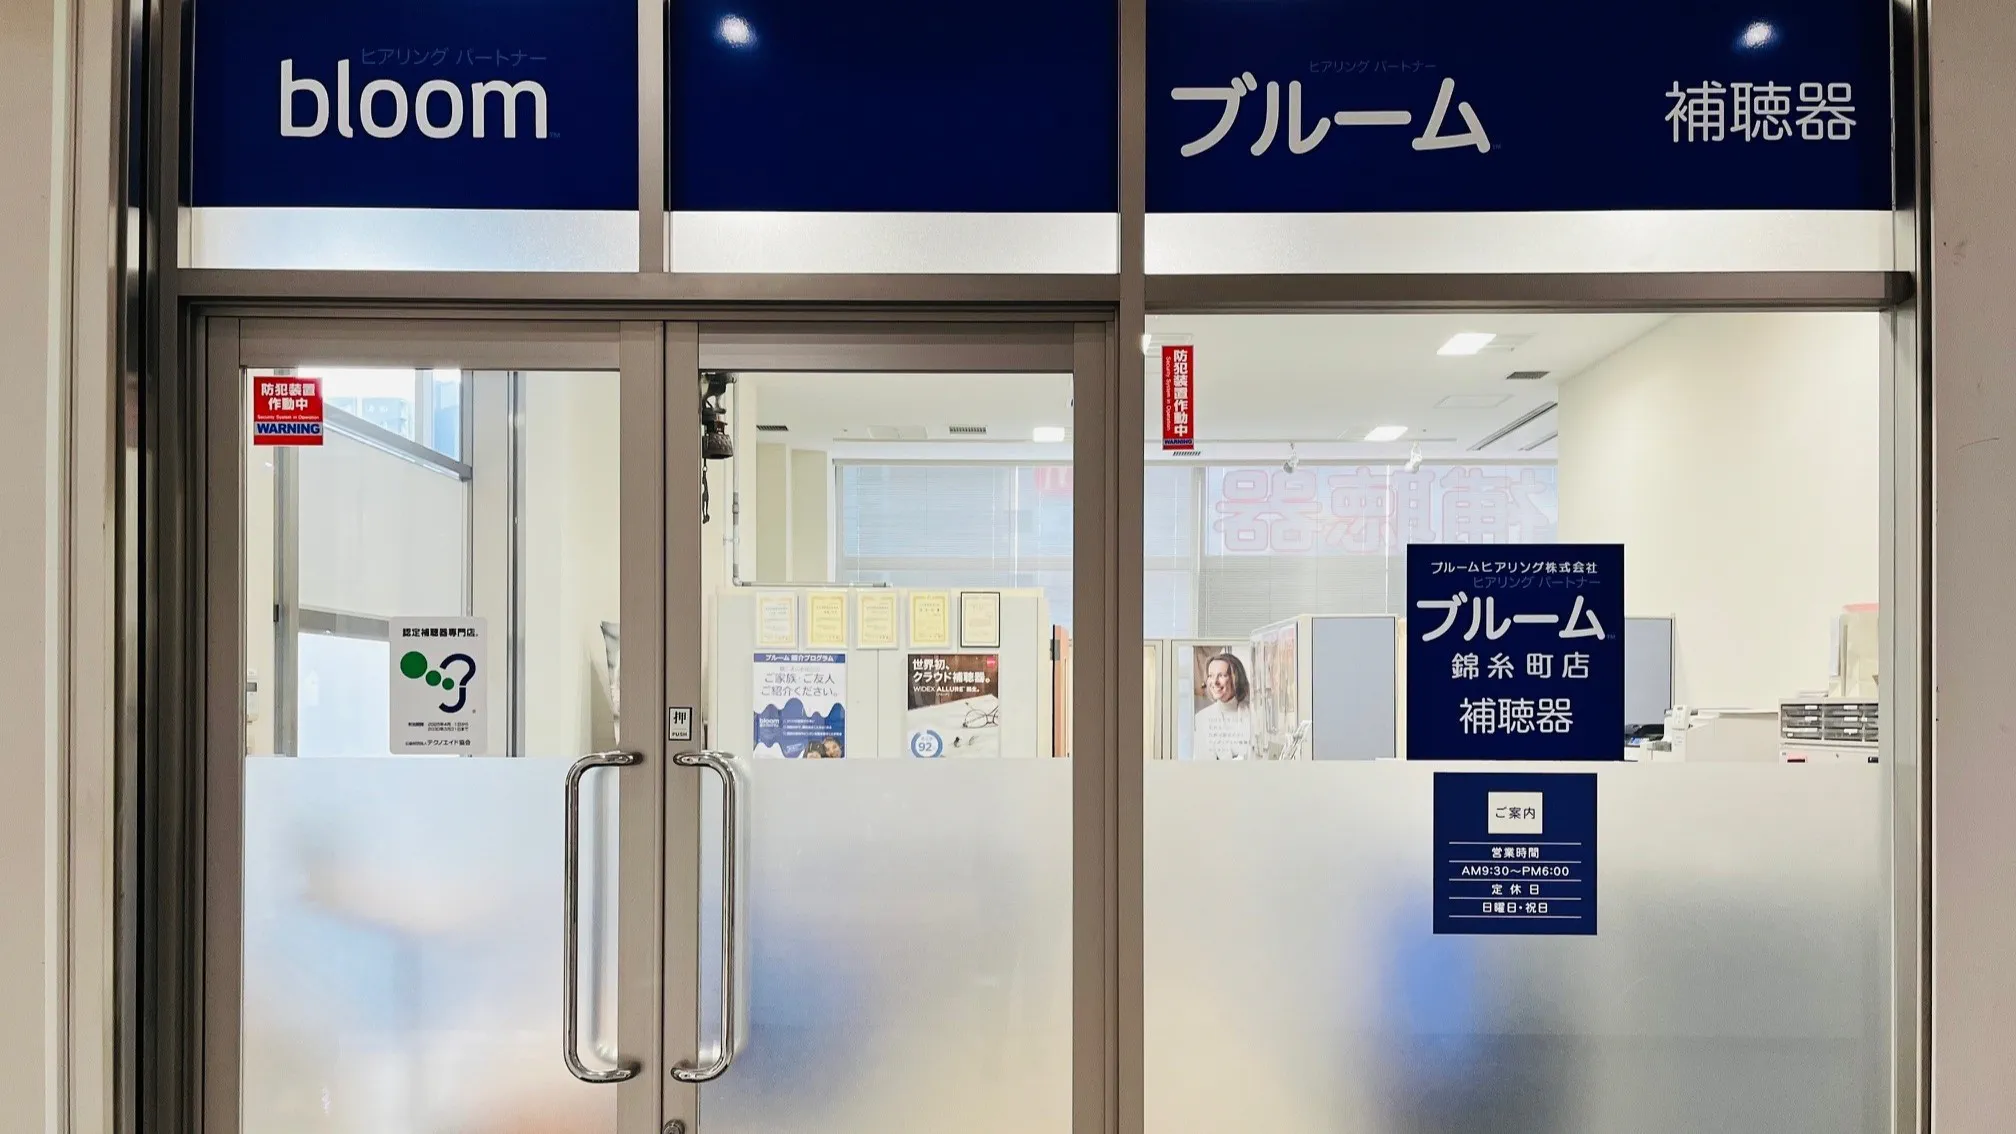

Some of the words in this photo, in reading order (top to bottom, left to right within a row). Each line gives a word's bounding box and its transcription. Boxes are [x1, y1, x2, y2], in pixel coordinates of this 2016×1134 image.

[361, 47, 450, 66] ヒアリング
[456, 48, 547, 67] パートナー
[1309, 60, 1370, 73] ヒアリング
[1374, 60, 1436, 73] パートナー
[280, 58, 548, 139] bloom
[1171, 71, 1491, 158] ブルーム
[1664, 79, 1857, 143] 補聴器
[261, 383, 315, 396] 防犯装置
[1173, 349, 1188, 437] 防犯装置作動中
[268, 397, 308, 411] 作動中
[257, 423, 320, 434] WARNING
[1431, 561, 1598, 575] ブルームヒアリング株式会社
[1473, 576, 1535, 589] ヒアリング
[1538, 576, 1600, 589] パートナー
[1416, 591, 1605, 641] ブルーム
[402, 628, 475, 637] 認定補聴器専門店
[1451, 652, 1590, 680] 錦糸町店
[1459, 697, 1574, 734] 補聴器
[1495, 806, 1536, 819] ご案内
[1491, 847, 1539, 859] 営業時間
[1491, 884, 1539, 895] 定休日
[1482, 901, 1548, 914] 日曜日・祝日
